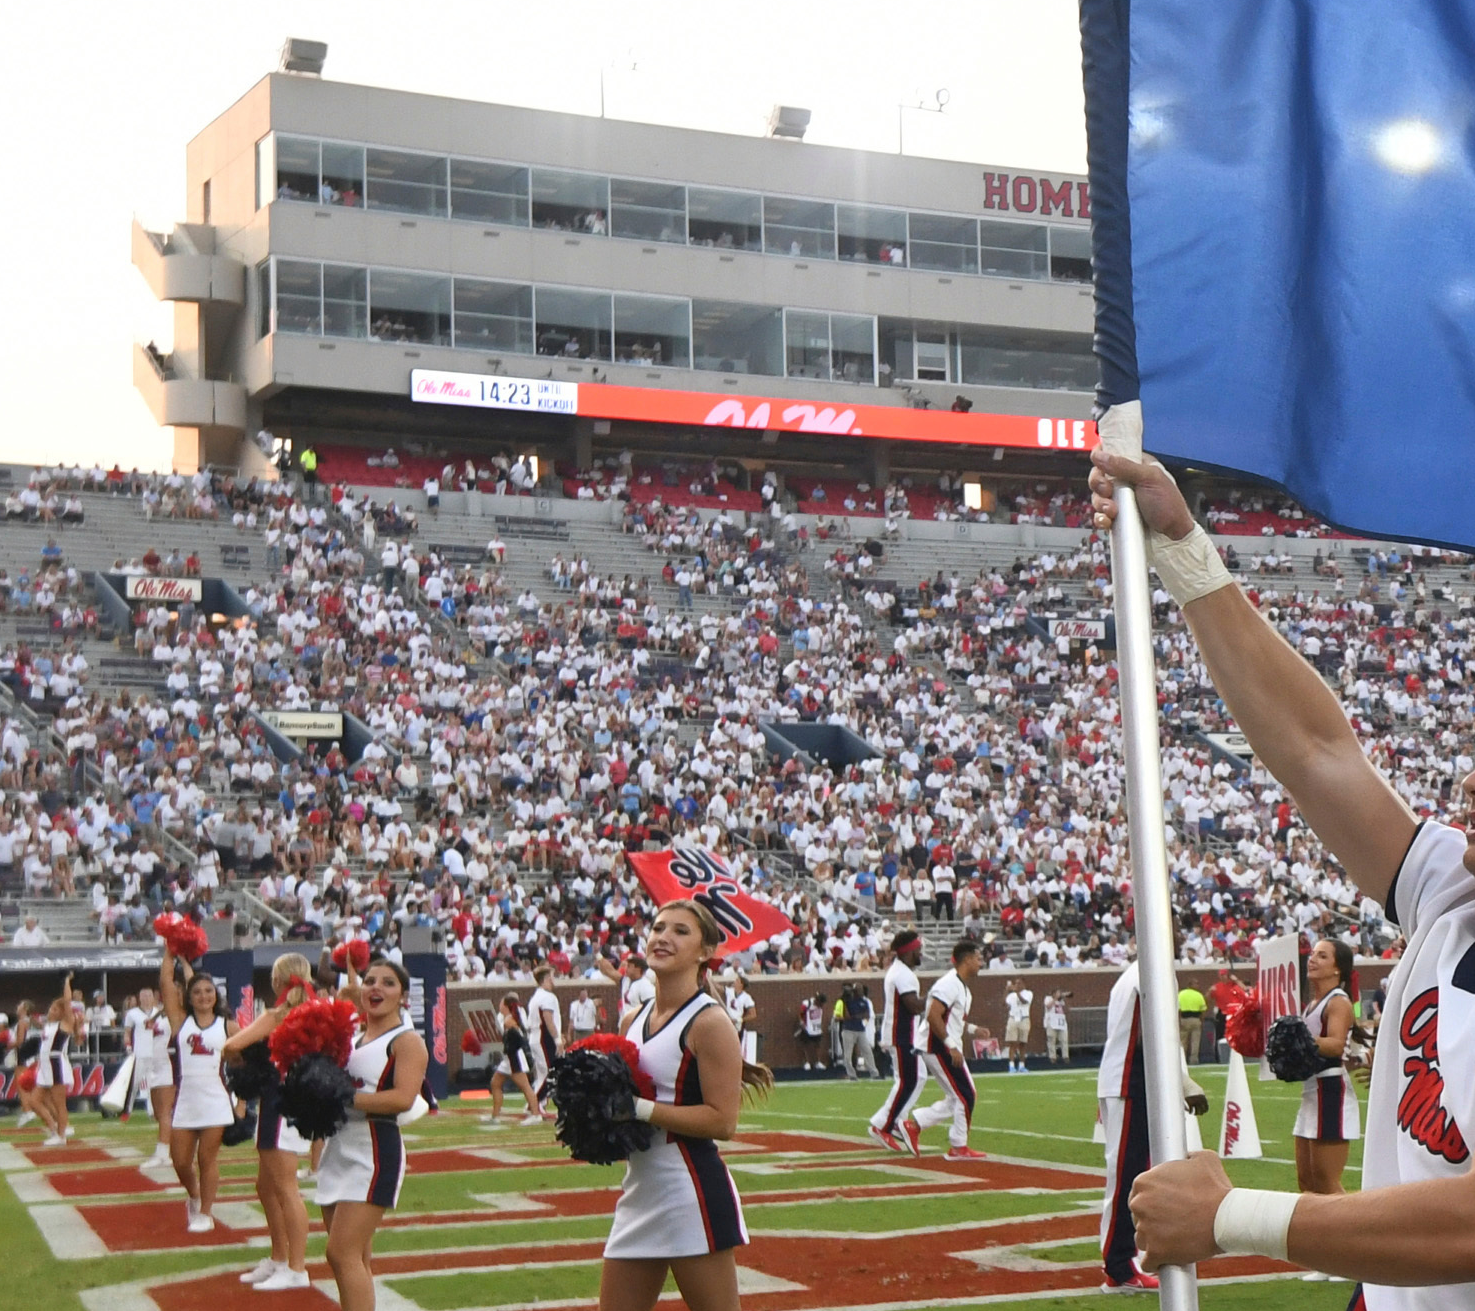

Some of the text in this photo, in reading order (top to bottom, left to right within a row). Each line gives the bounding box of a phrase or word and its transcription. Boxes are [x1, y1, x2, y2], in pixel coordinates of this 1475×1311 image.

[439, 380, 471, 398] Miss
[480, 381, 530, 405] 14:23
[1038, 419, 1085, 448] OLE
[134, 578, 157, 597] Ole
[1072, 621, 1099, 637] Miss
